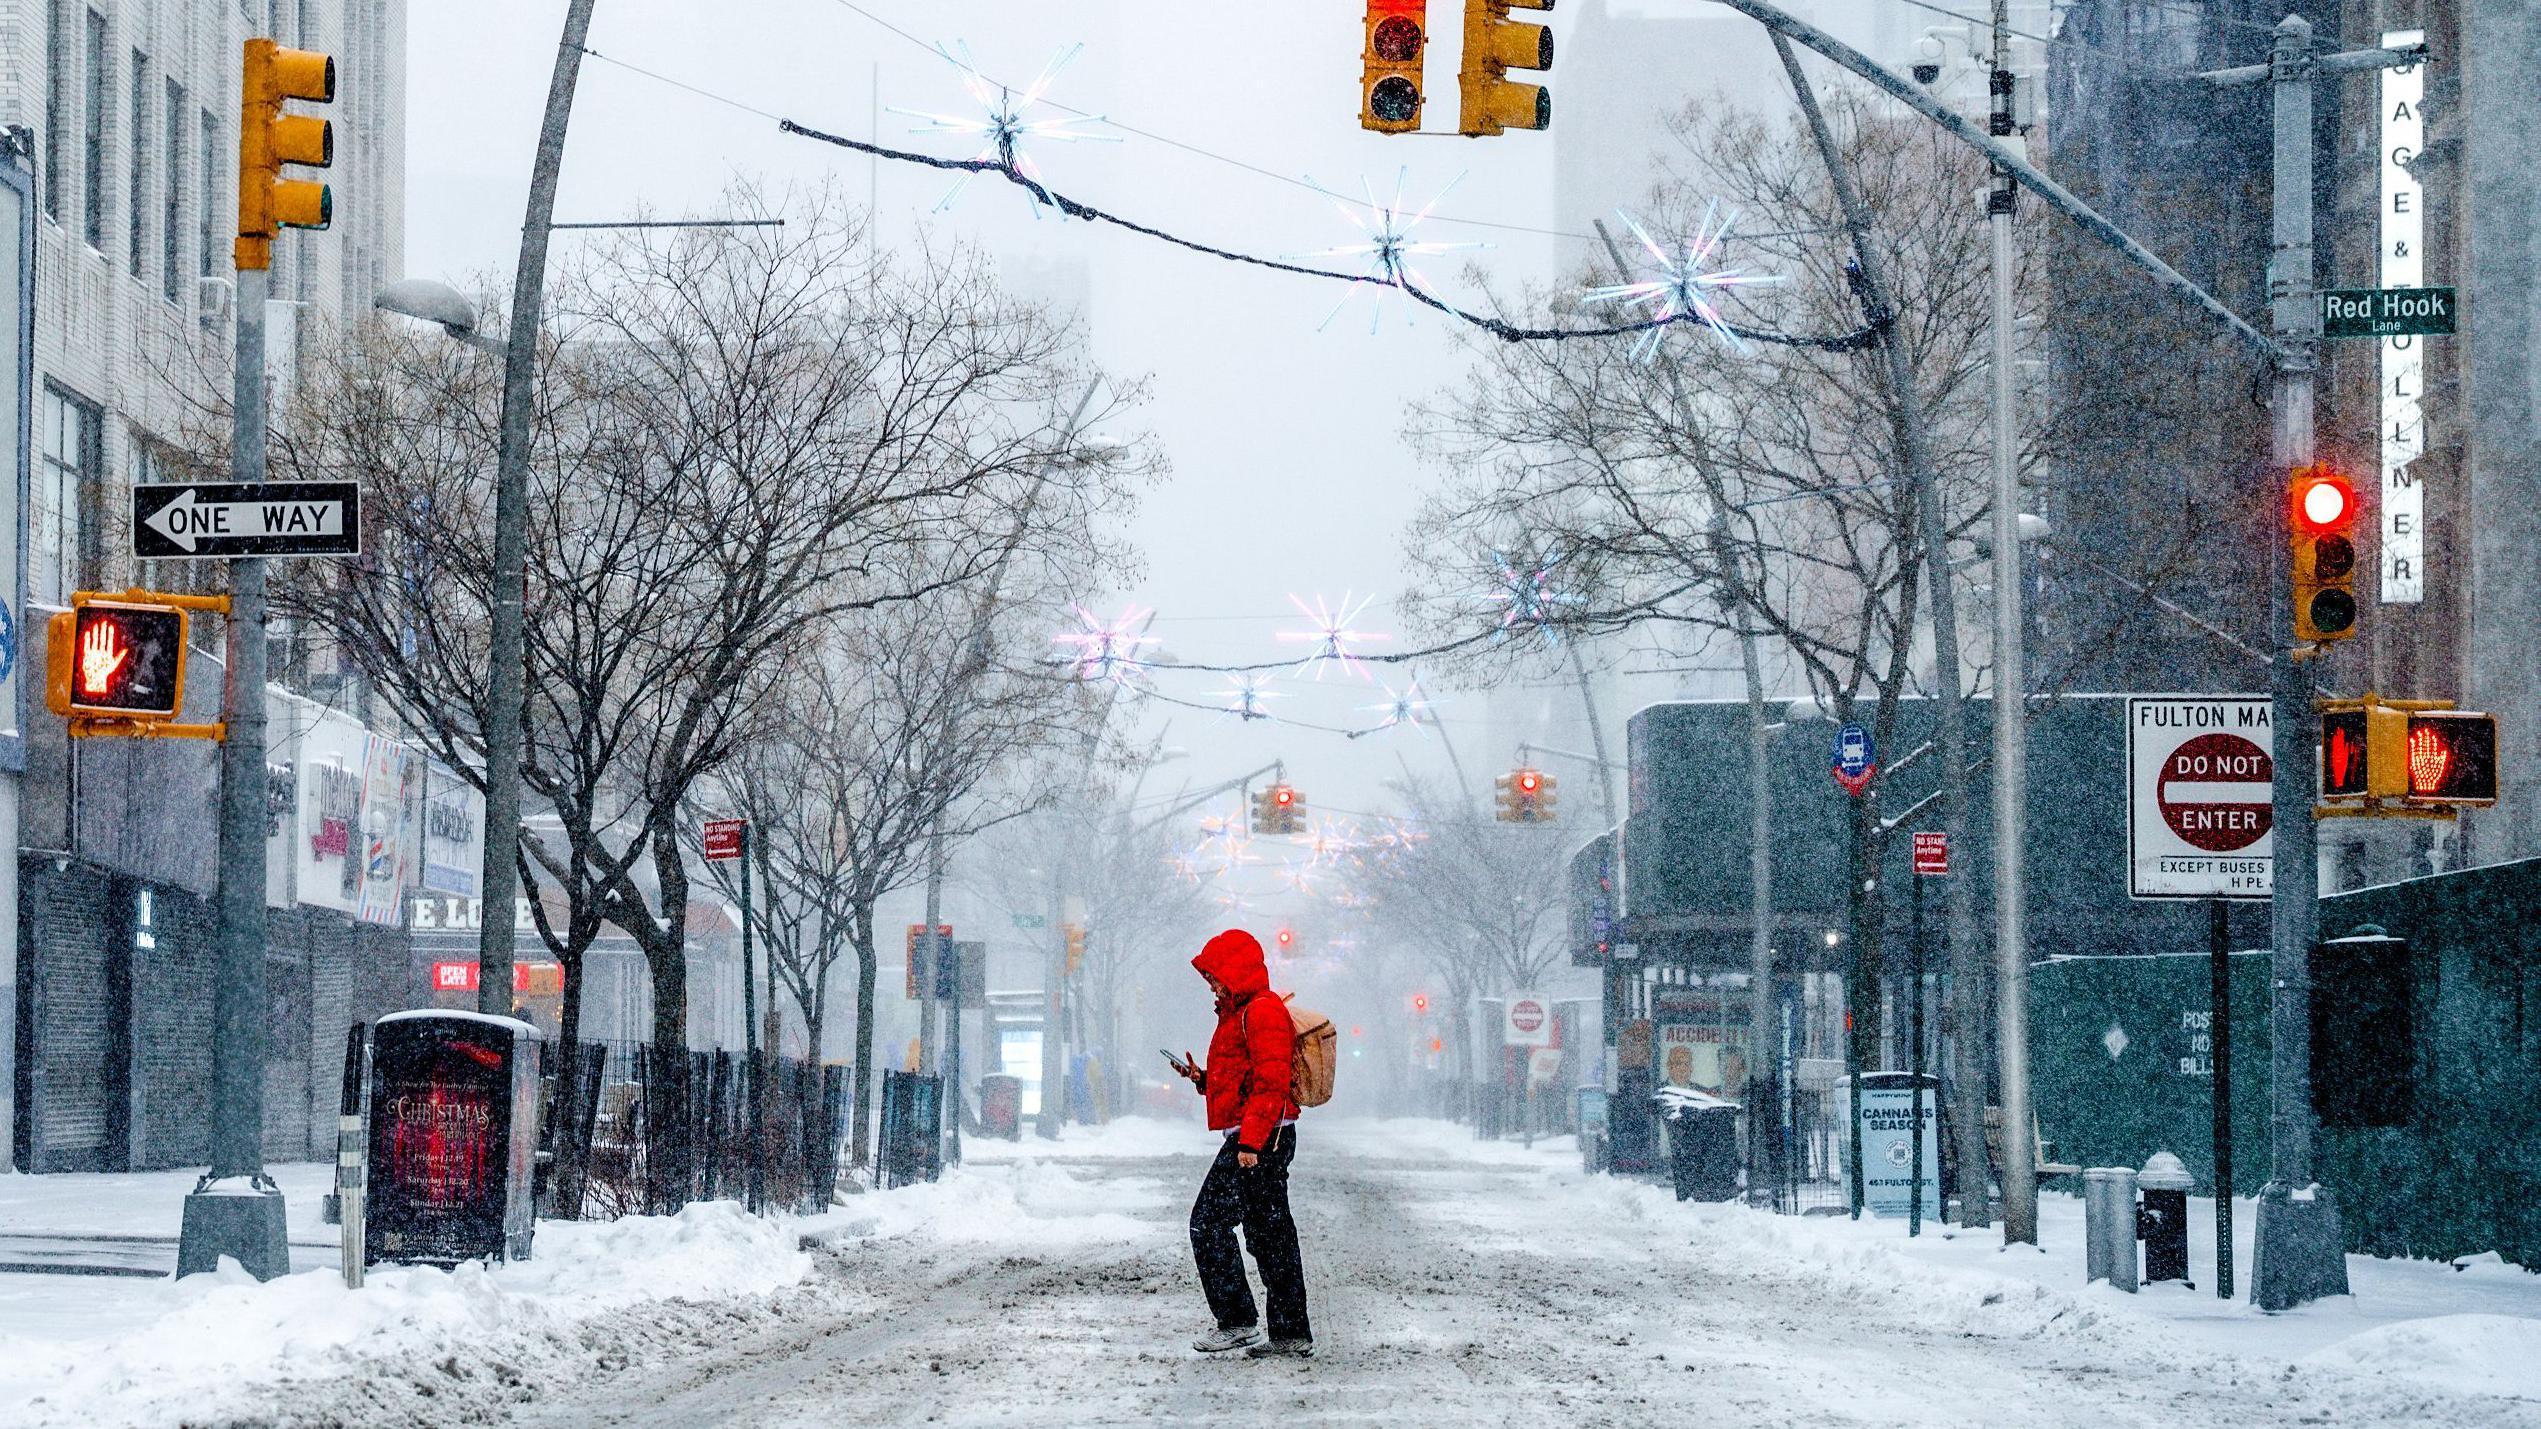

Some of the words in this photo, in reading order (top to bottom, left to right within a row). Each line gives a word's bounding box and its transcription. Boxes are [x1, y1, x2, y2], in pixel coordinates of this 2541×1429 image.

[2394, 240, 2408, 257] &
[2327, 295, 2371, 318] Red
[2383, 293, 2445, 317] Hook
[2372, 320, 2400, 332] Lane
[2392, 283, 2412, 580] OLLNER
[168, 506, 230, 534] ONE
[262, 505, 329, 532] WAY
[2141, 706, 2225, 727] FULTON
[2177, 755, 2208, 774] DO
[2217, 755, 2262, 774] NOT
[2182, 811, 2257, 829] ENTER
[714, 823, 740, 832] STANDING
[1916, 837, 1926, 845] NO
[1917, 846, 1942, 856] Anytime
[2160, 861, 2213, 873] EXCEPT
[2219, 862, 2265, 873] BUSES
[441, 965, 467, 976] OPEN
[441, 975, 467, 986] LATE
[386, 1095, 490, 1130] CHRISTMAS
[1862, 1108, 1934, 1119] CANNAS
[414, 1153, 439, 1162] Friday
[408, 1176, 441, 1187] Saturday
[410, 1199, 439, 1208] Sunday
